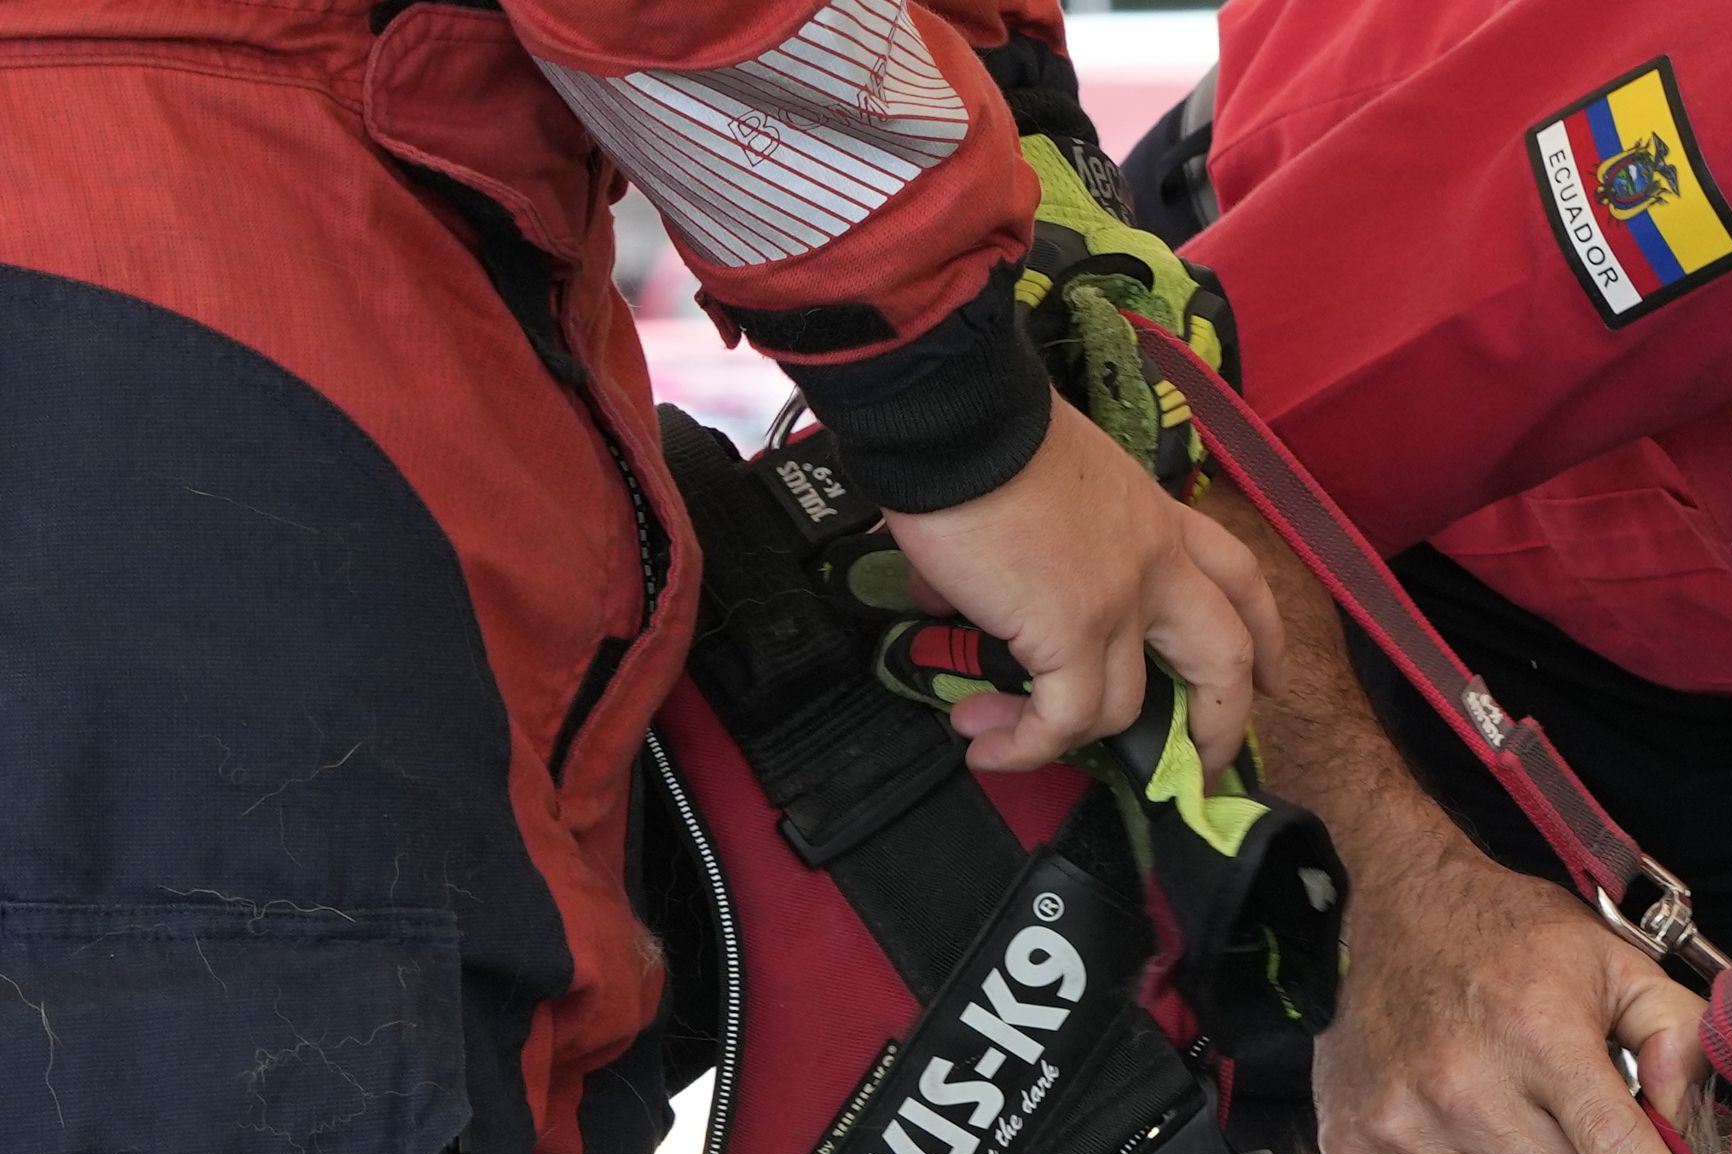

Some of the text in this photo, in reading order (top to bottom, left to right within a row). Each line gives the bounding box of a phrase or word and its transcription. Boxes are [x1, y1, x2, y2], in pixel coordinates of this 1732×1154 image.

[1549, 150, 1618, 288] ECUADOR
[776, 460, 838, 523] JULIUS
[995, 1116, 1023, 1147] the
[1021, 1059, 1060, 1114] dark
